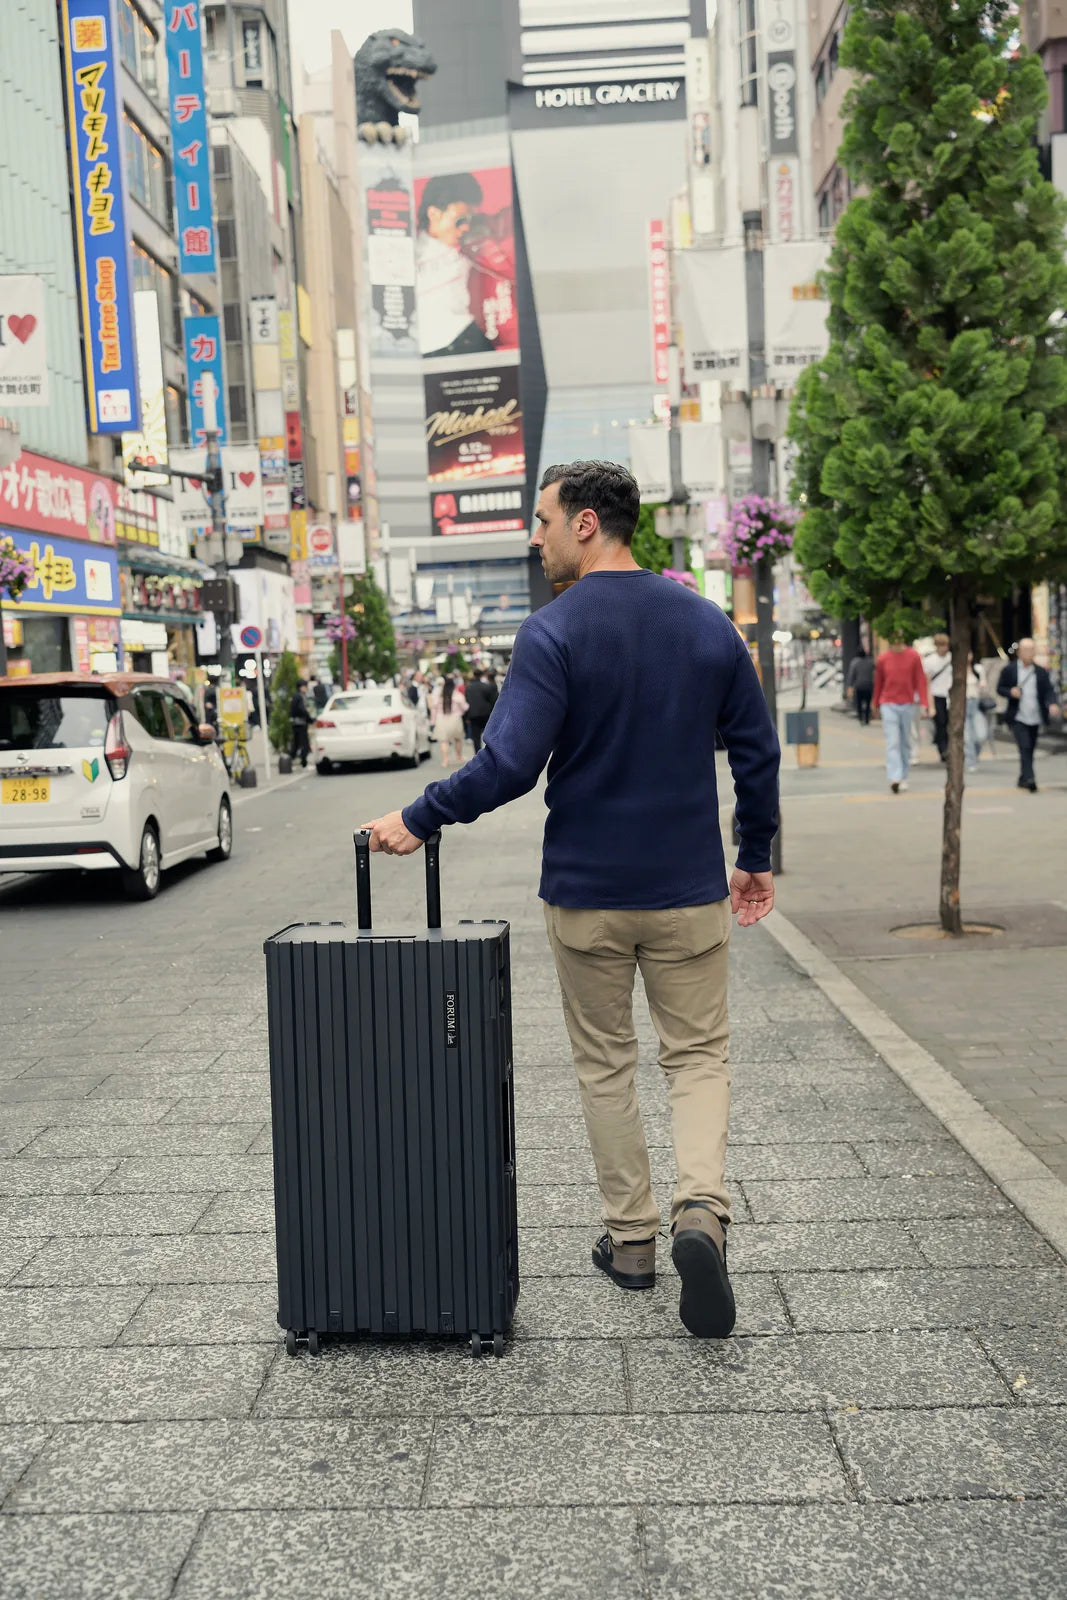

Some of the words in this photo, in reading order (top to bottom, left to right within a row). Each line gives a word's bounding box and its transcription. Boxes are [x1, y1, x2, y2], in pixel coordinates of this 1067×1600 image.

[535, 86, 595, 108] HOTEL
[596, 81, 680, 105] GRACERY
[96, 257, 116, 302] Shop
[102, 340, 121, 374] Tax
[0, 459, 87, 527] オケ歌広場
[230, 472, 238, 490] I
[446, 993, 456, 1030] FORUM
